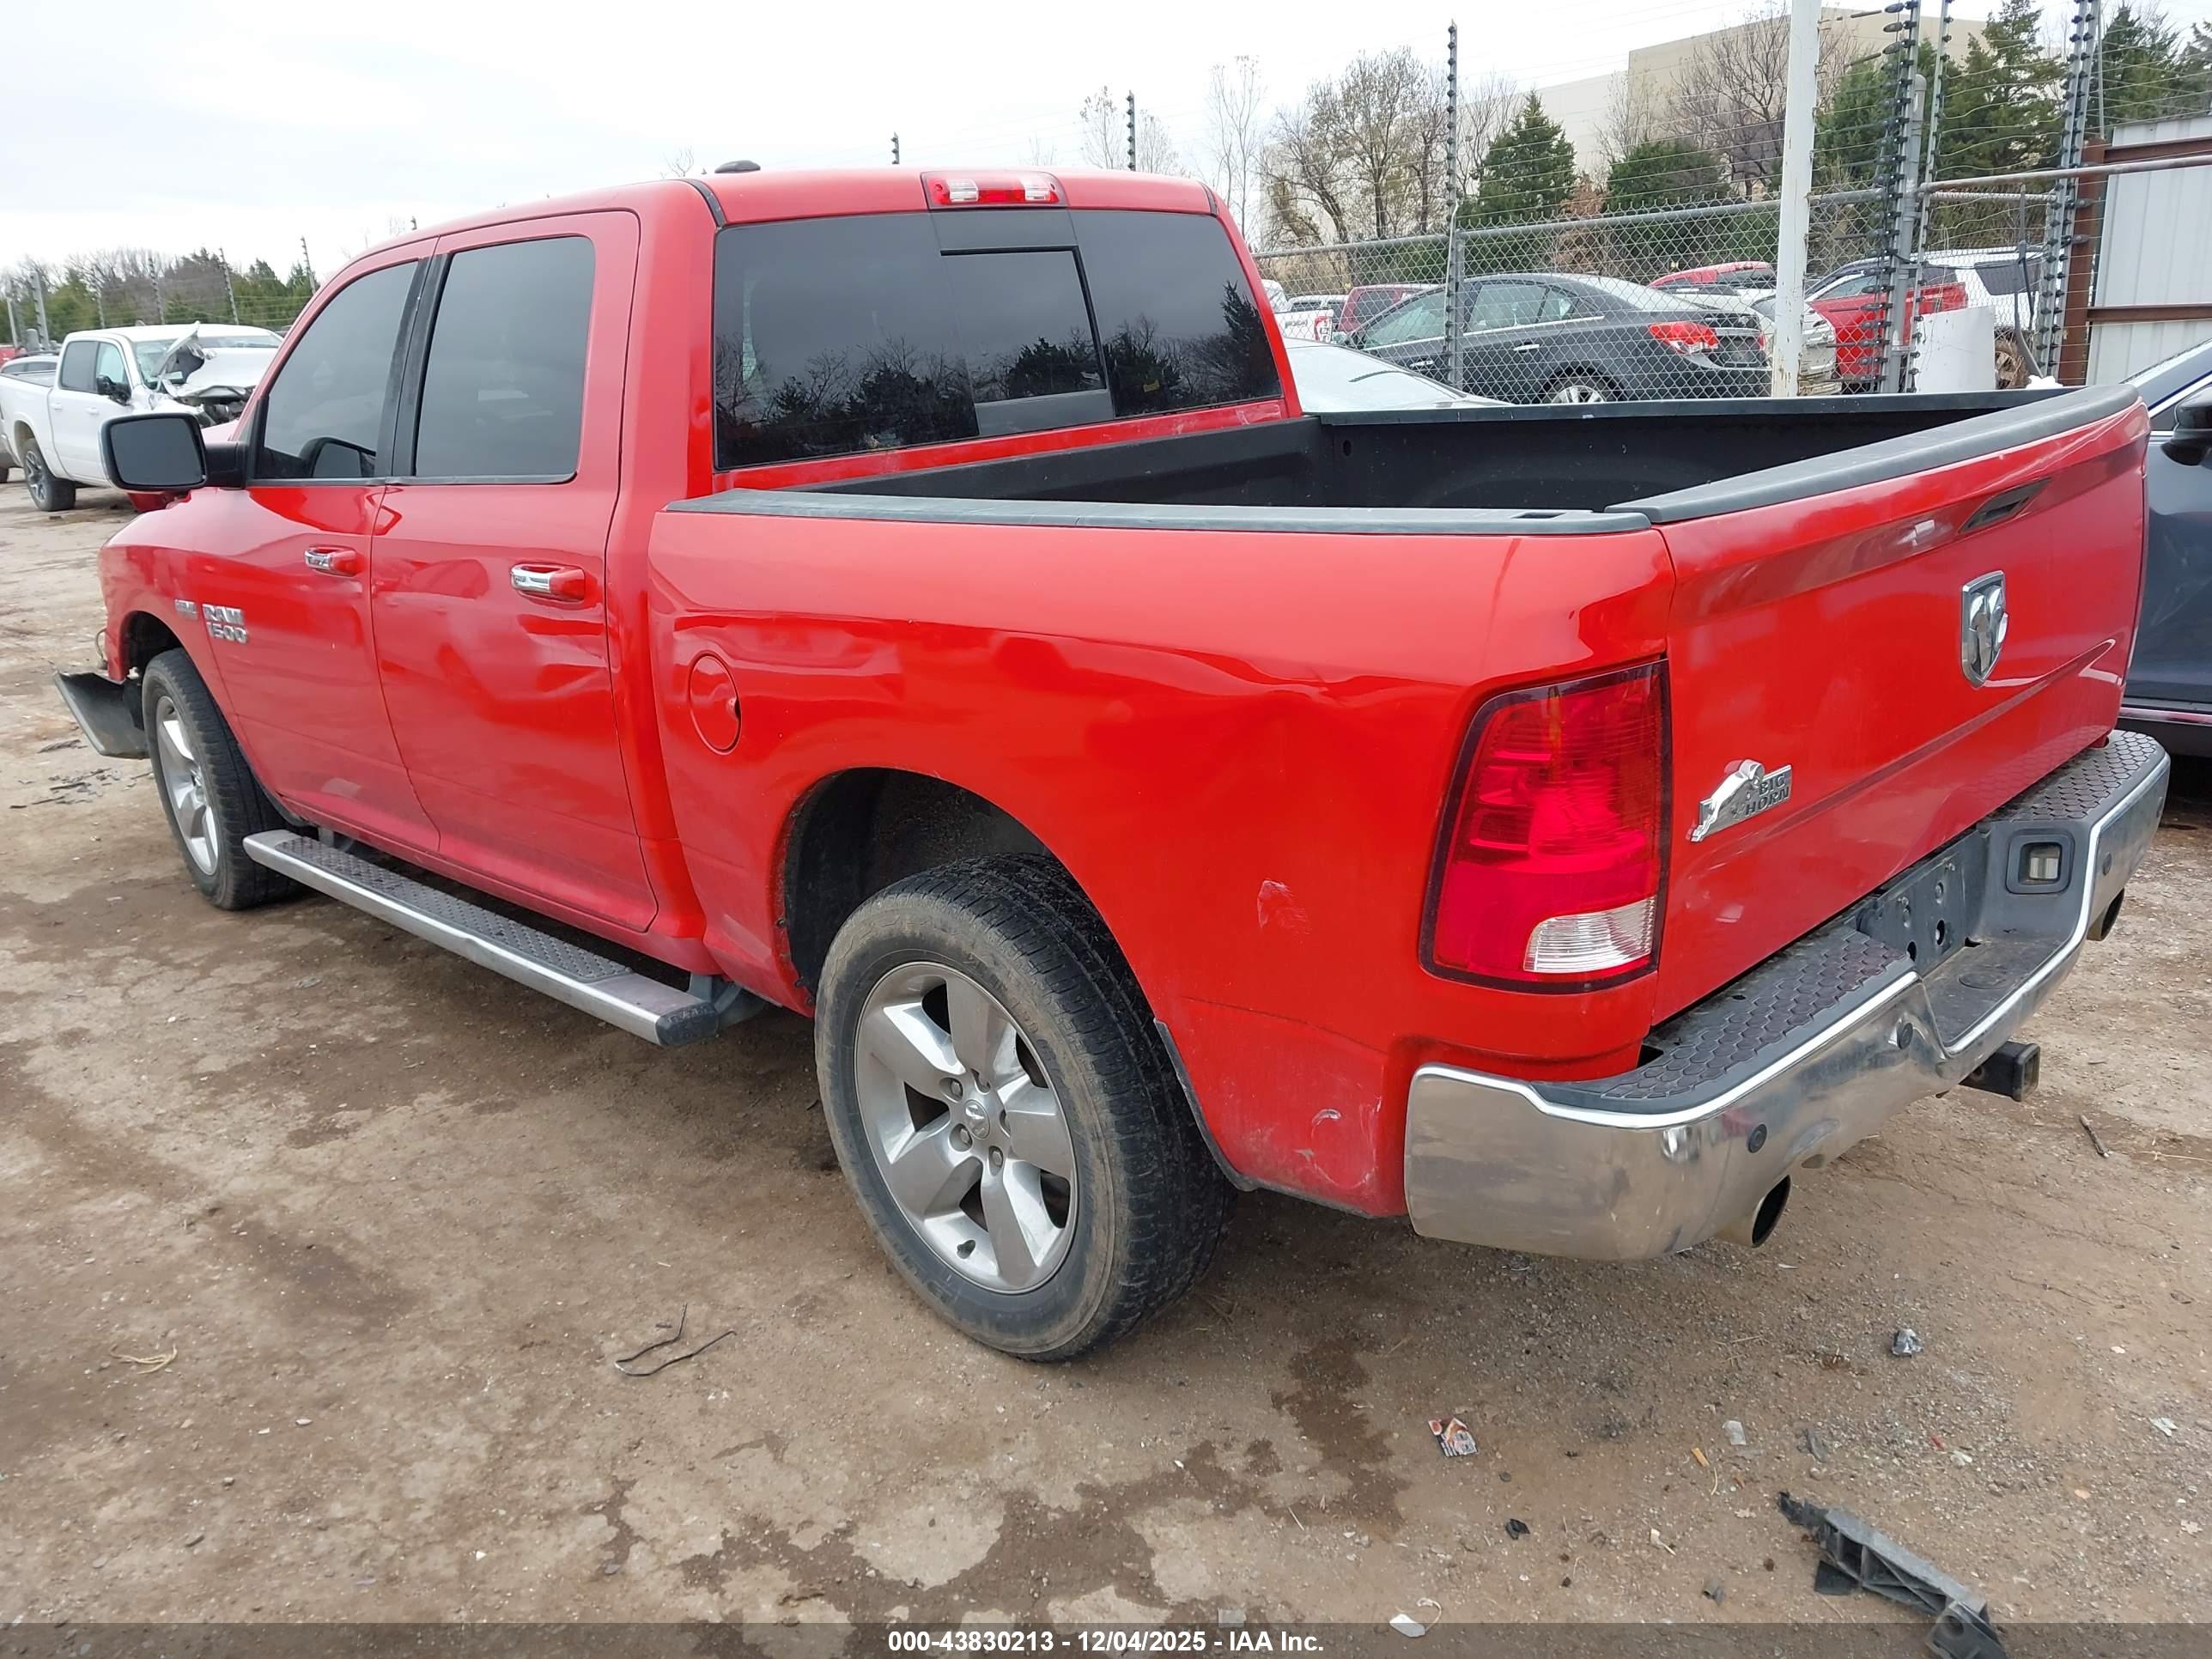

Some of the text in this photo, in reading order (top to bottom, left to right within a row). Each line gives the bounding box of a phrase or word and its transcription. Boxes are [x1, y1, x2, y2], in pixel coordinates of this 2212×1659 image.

[202, 604, 244, 626] RAM
[206, 622, 247, 644] 1500
[1759, 773, 1786, 795] BIG
[1745, 786, 1790, 816] HORN
